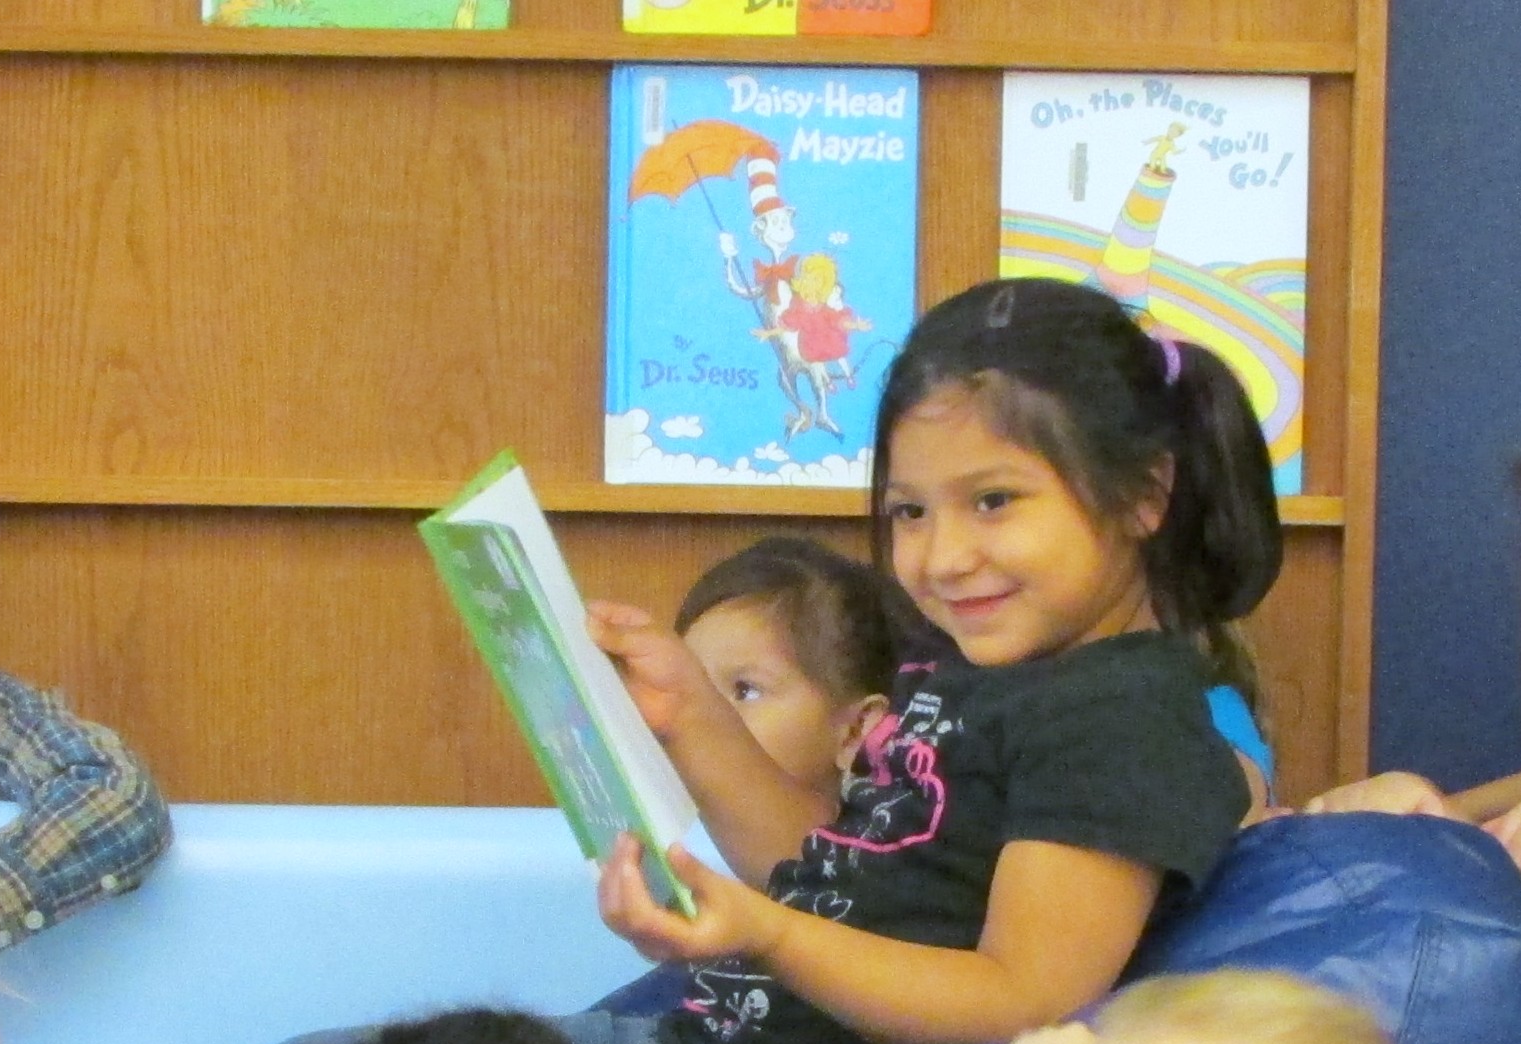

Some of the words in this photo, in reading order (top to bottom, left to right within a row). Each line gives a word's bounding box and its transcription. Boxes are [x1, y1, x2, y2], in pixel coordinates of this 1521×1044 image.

[725, 74, 907, 119] Daisy-Head
[1089, 88, 1135, 112] the
[1143, 78, 1228, 128] Places
[788, 126, 905, 166] Mayzie
[1199, 131, 1269, 162] You'll
[1229, 151, 1295, 190] Go!
[640, 358, 680, 389] Dr.
[687, 353, 759, 390] Seuss
